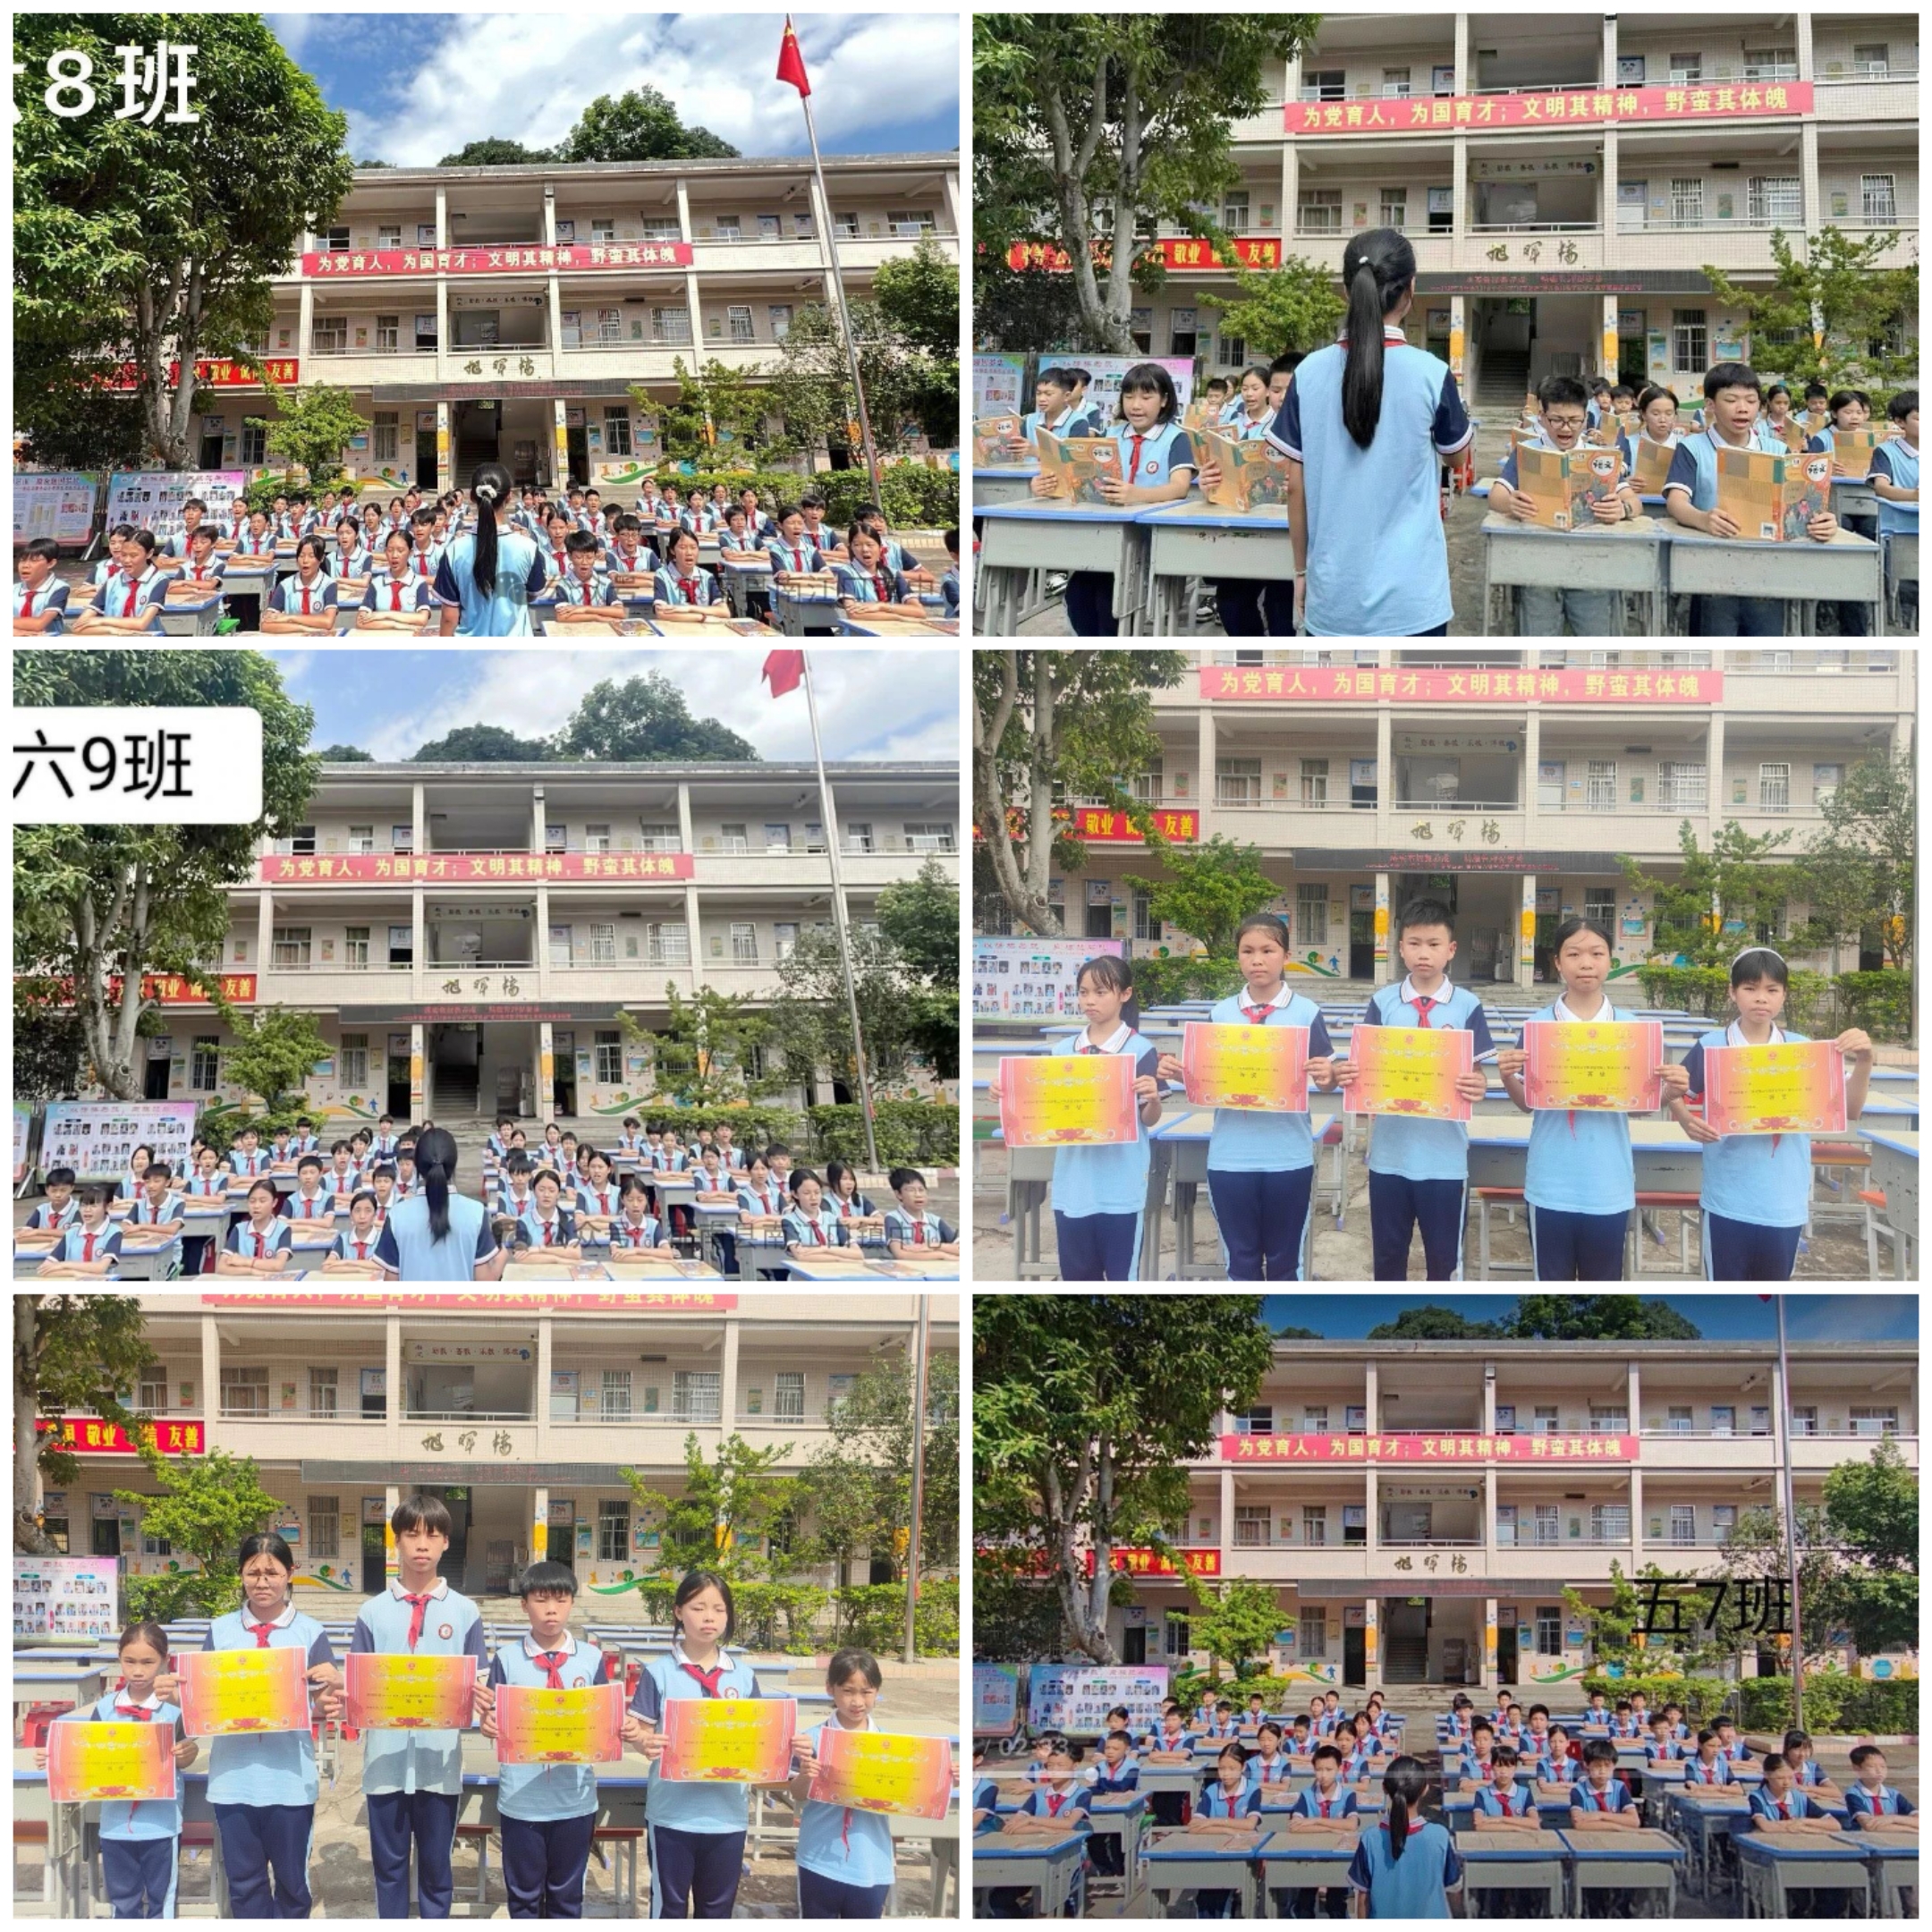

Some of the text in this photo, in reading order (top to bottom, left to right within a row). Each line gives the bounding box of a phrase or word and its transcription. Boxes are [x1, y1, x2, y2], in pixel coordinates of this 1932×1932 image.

[271, 361, 293, 380] 友善
[1807, 463, 1827, 474] 语文
[1085, 812, 1114, 835] 敬业
[1164, 814, 1193, 836] 友善
[225, 978, 251, 997] 友善
[86, 1423, 117, 1446] 敬业
[168, 1425, 199, 1449] 友善
